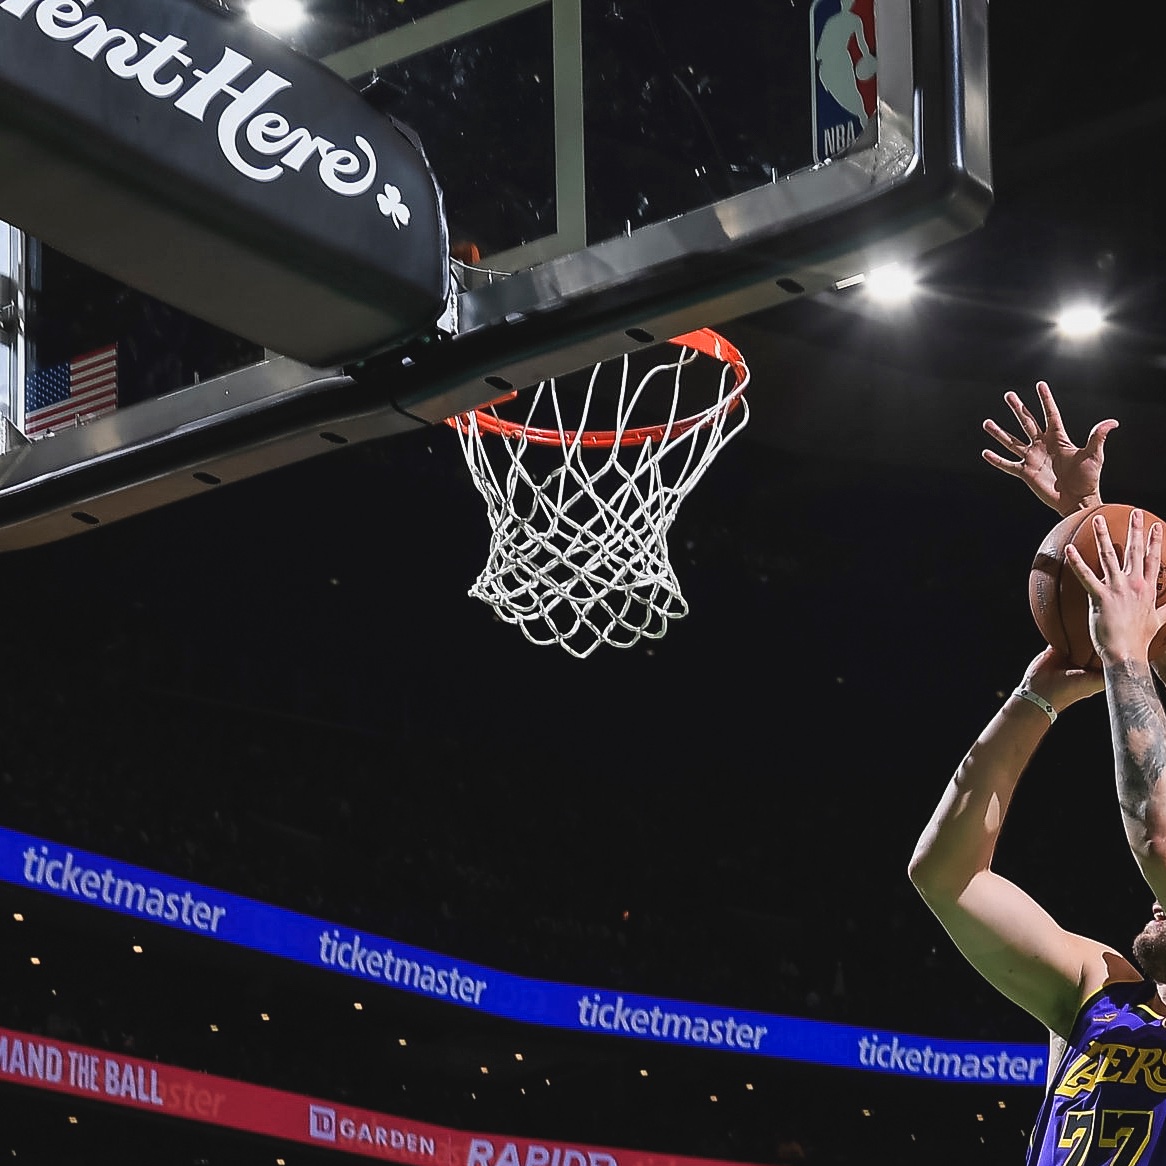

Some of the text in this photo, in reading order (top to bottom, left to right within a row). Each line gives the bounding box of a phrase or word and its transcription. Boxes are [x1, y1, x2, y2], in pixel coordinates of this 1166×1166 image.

[0, 0, 193, 98] ent
[823, 120, 856, 157] NBA
[22, 845, 227, 933] ticketmaster
[319, 929, 487, 1005] ticketmaster
[577, 993, 768, 1050] ticketmaster
[857, 1033, 1044, 1081] ticketmaster
[67, 1050, 99, 1092] THE
[104, 1058, 164, 1106] BALL
[339, 1118, 435, 1156] GARDEN
